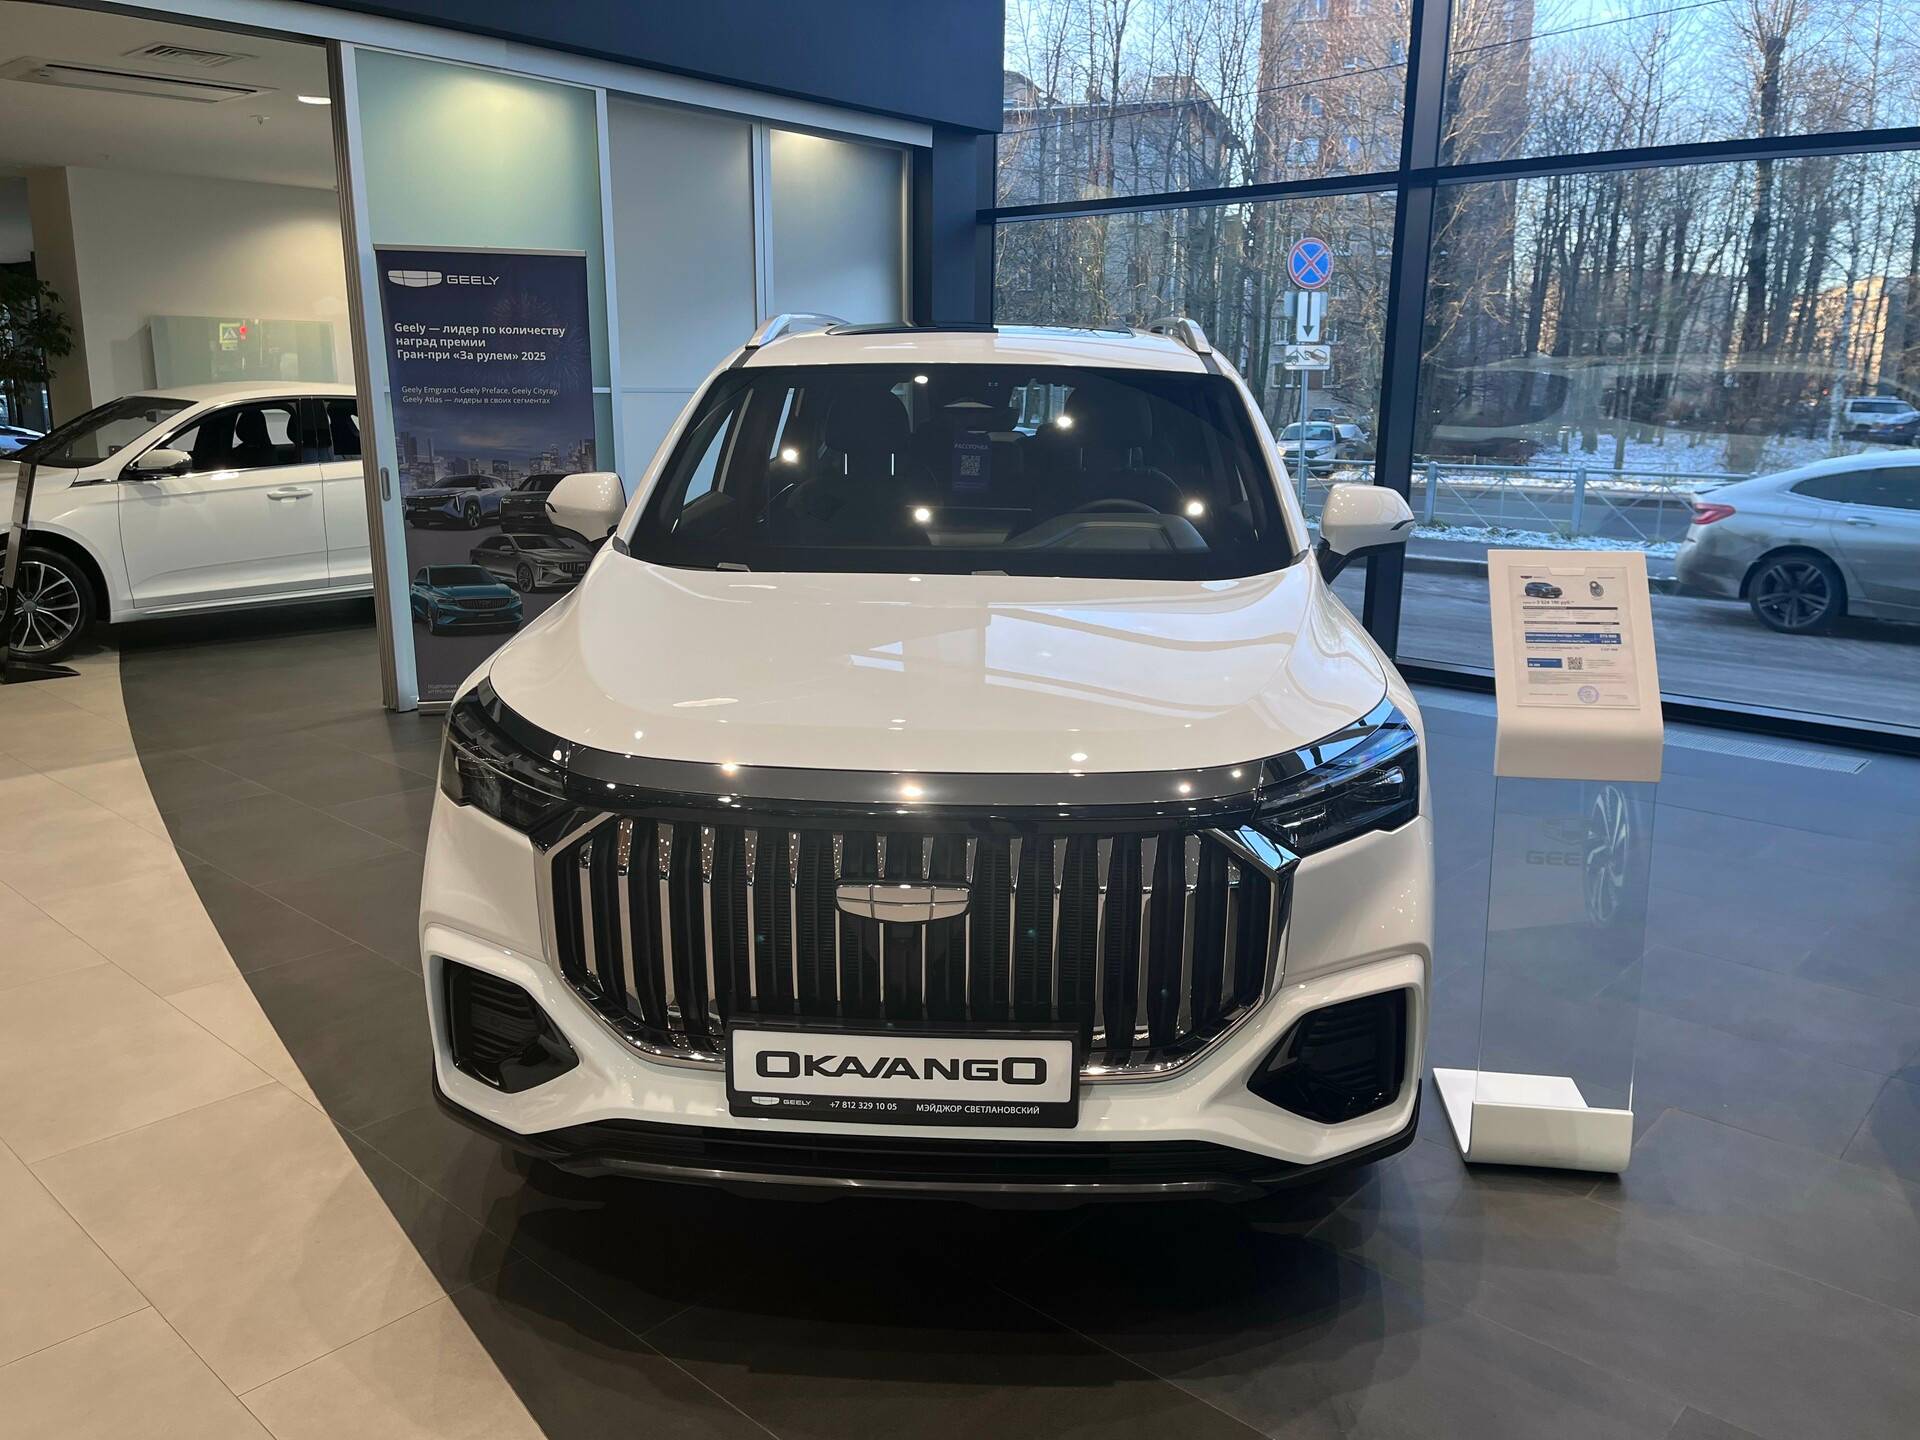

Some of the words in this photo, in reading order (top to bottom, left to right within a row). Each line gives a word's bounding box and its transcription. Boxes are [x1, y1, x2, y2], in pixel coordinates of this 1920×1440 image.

[447, 275, 500, 285] GEELY
[394, 322, 426, 335] Geely
[443, 325, 480, 336] лидер
[482, 326, 496, 334] по
[499, 326, 566, 338] количеству
[396, 338, 438, 348] наград
[440, 338, 486, 349] премии
[397, 349, 450, 362] Гран-при
[453, 350, 474, 360] «За
[476, 352, 519, 362] рулем»
[521, 351, 546, 361] 2025
[401, 386, 423, 395] Geely
[423, 386, 459, 395] Emgrand,
[460, 386, 480, 395] Geely
[481, 387, 510, 395] Preface,
[511, 387, 532, 396] Geely
[402, 396, 423, 404] Geely
[755, 1050, 1048, 1086] OKAVANGO
[783, 1099, 812, 1107] GEELY
[829, 1101, 840, 1109] +7
[841, 1101, 856, 1109] 812
[857, 1101, 873, 1110] 329
[875, 1102, 886, 1110] 10
[887, 1102, 898, 1111] 05
[916, 1103, 962, 1114] МЭЙДЖОР
[964, 1104, 1040, 1115] СВЕТЛАНОВСКИЙ
